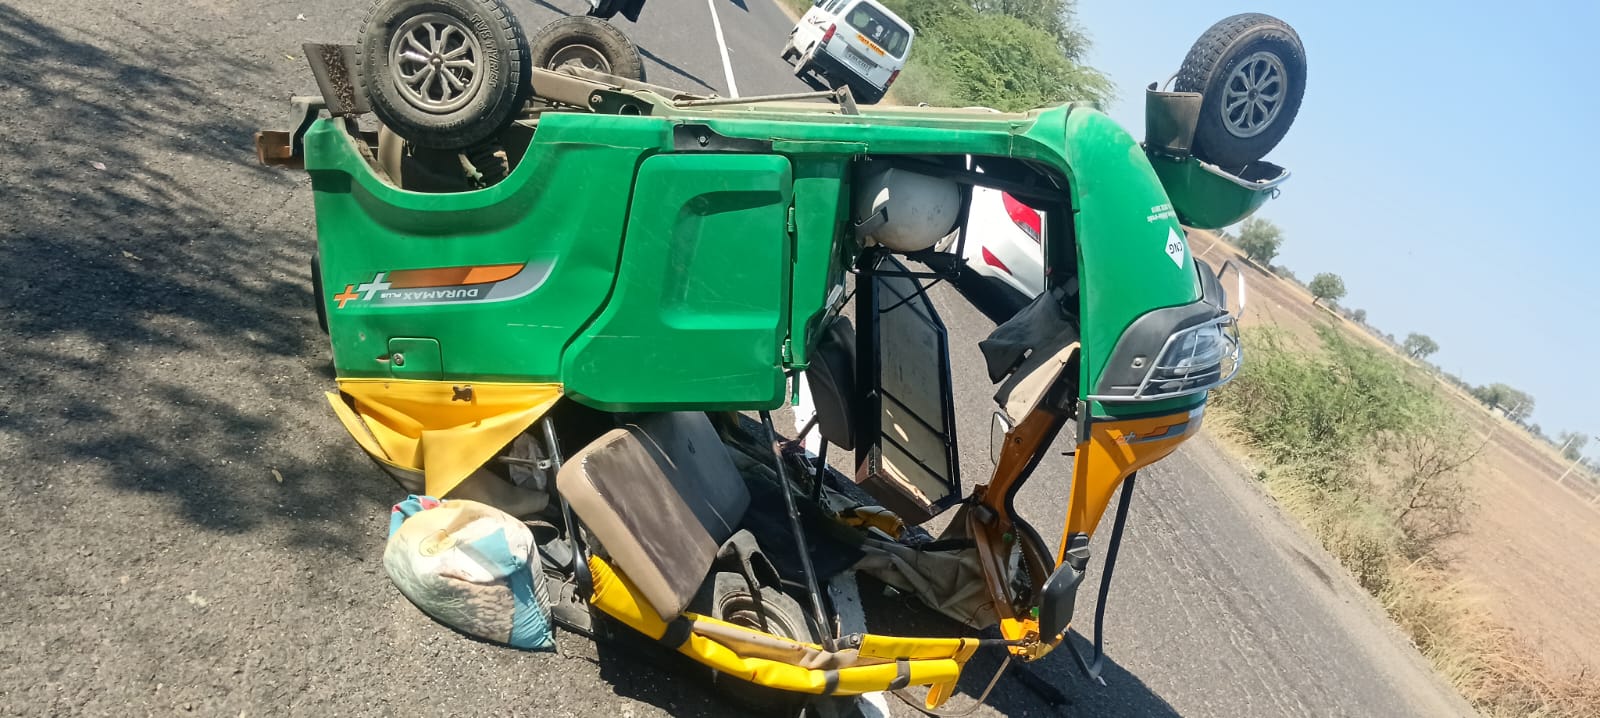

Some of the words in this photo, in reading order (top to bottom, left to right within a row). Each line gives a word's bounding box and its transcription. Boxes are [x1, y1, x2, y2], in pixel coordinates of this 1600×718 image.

[472, 14, 493, 40] TVS
[1168, 241, 1183, 254] CNG
[402, 289, 478, 300] DURAMAX
